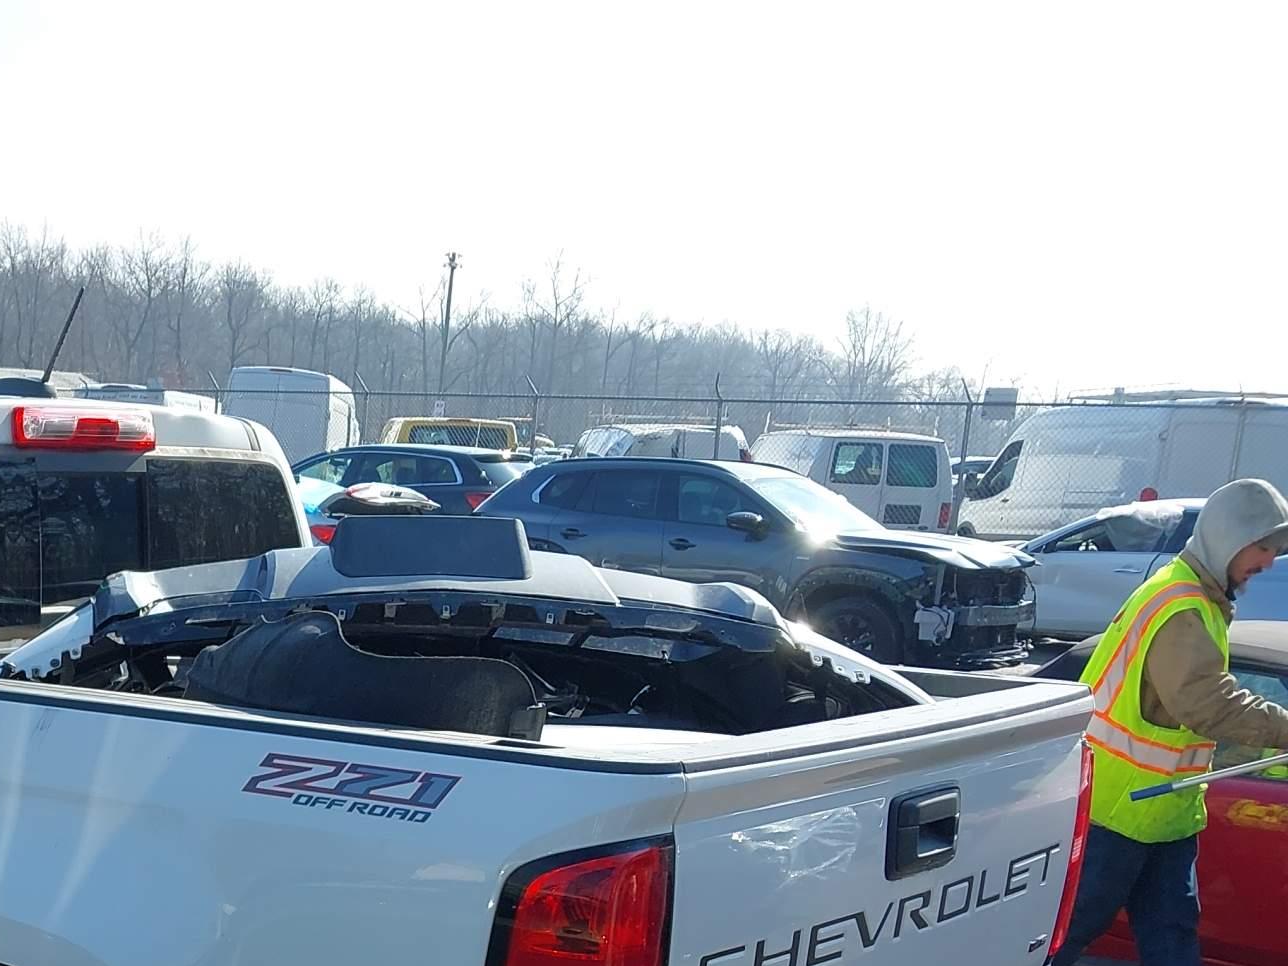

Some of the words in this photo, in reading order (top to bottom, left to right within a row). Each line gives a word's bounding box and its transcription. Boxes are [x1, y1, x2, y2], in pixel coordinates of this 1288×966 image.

[241, 752, 463, 810] Z71
[292, 794, 348, 810] OFF
[347, 800, 432, 823] ROAD
